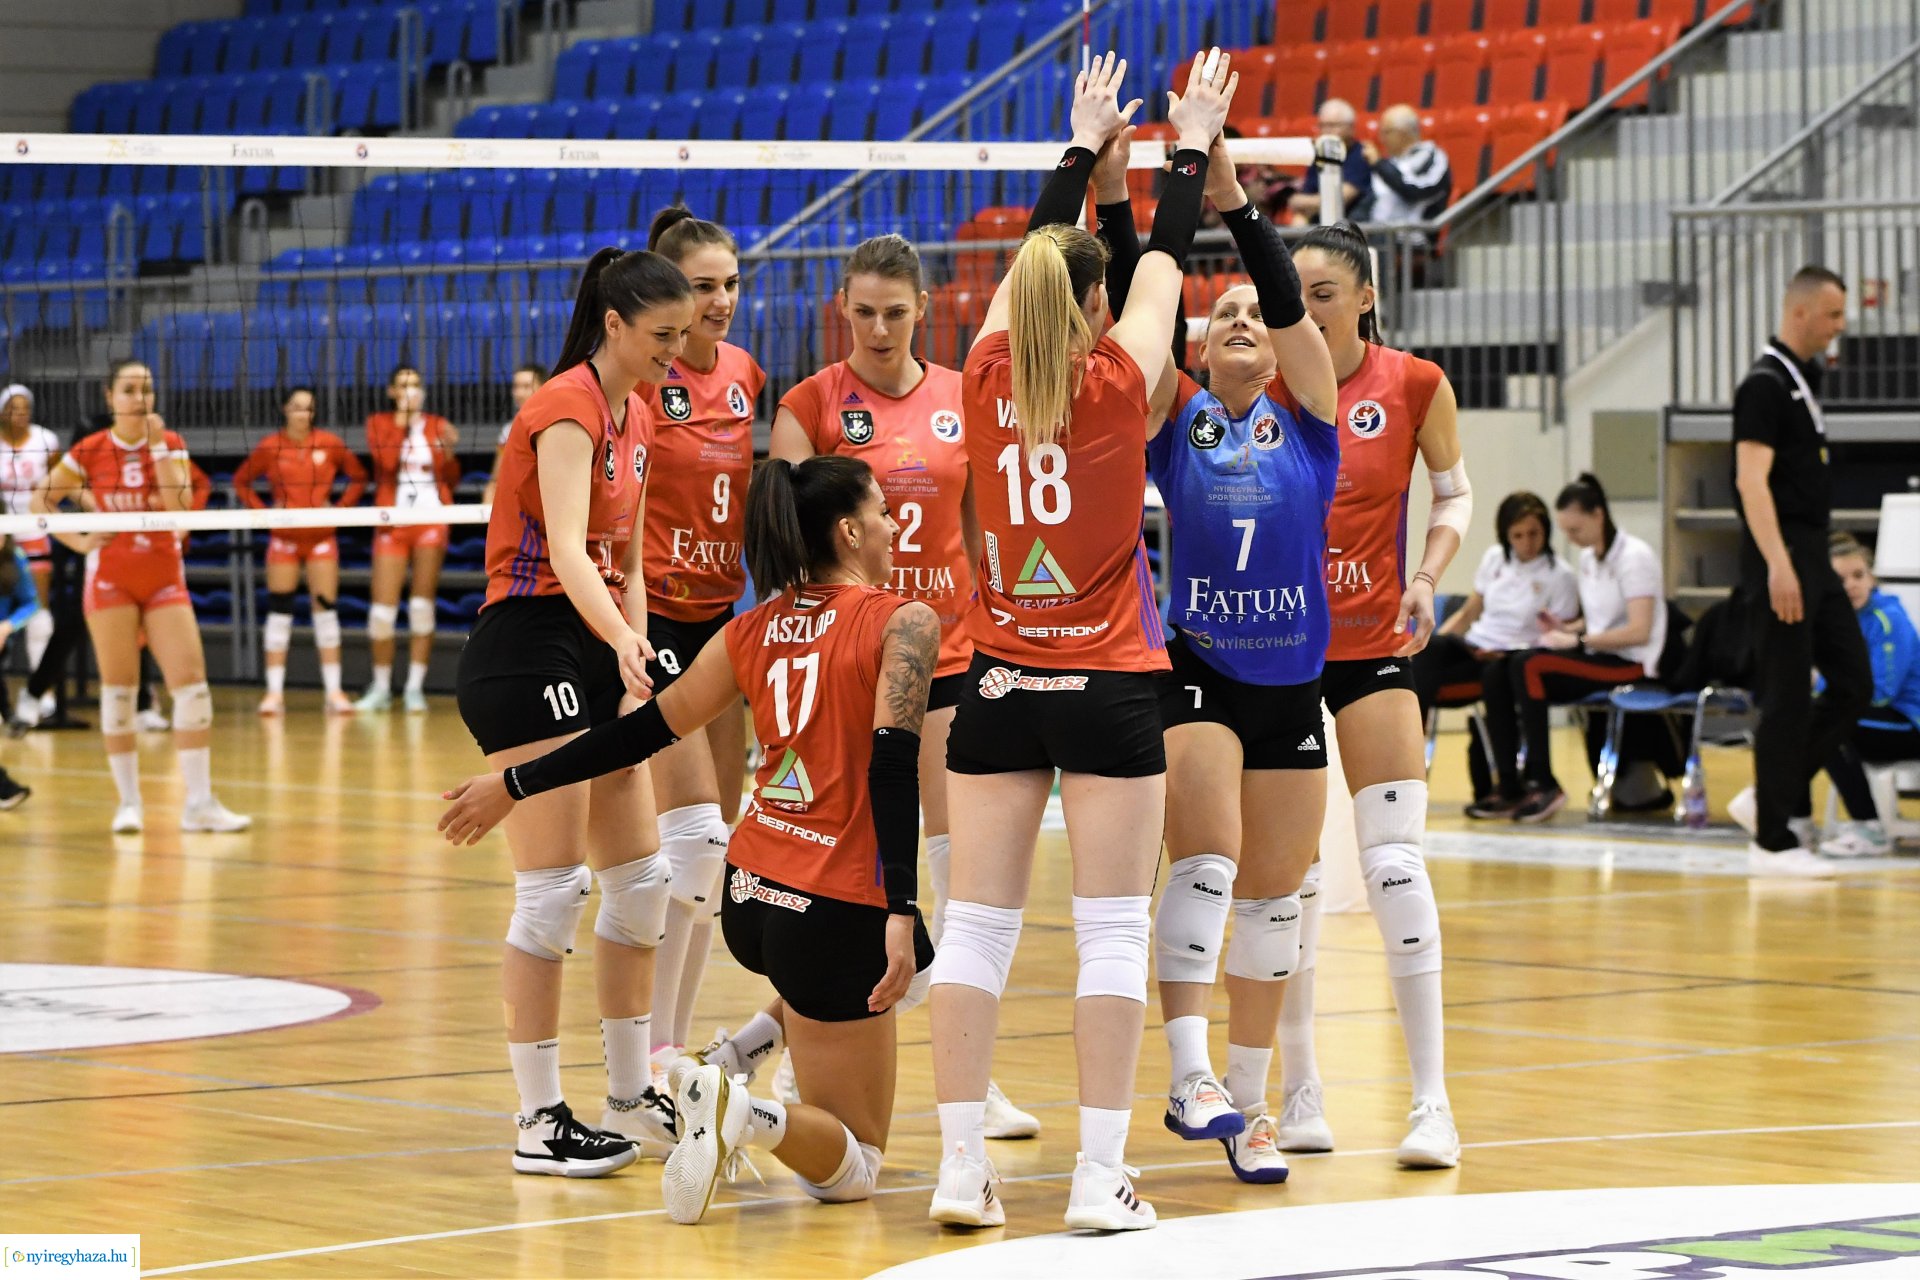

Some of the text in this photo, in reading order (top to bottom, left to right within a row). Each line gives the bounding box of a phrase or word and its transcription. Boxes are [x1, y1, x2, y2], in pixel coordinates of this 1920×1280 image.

[231, 143, 275, 158] FATUM
[559, 147, 600, 162] FATUM
[867, 148, 907, 163] FATUM
[123, 463, 144, 489] 6
[997, 443, 1072, 525] 18
[711, 473, 731, 524] 9
[1207, 493, 1271, 501] SPORTCENTRUM
[1231, 518, 1256, 571] 7
[1185, 577, 1307, 614] FATUM
[1185, 608, 1307, 624] PROPERTY
[1018, 619, 1110, 638] BESTRONG
[1216, 632, 1307, 650] NYÍREGYHÁZA
[1016, 675, 1088, 691] REVESZ
[543, 681, 580, 722] 10
[766, 652, 820, 738] 17
[1184, 685, 1202, 709] 7
[757, 813, 837, 847] BESTRONG
[1192, 882, 1222, 897] MIKASA
[1382, 877, 1413, 892] MIKASA
[754, 886, 811, 911] REVESZ
[1270, 914, 1298, 923] MIKASA
[746, 1039, 774, 1059] MIKASA
[752, 1105, 778, 1129] MIKASA
